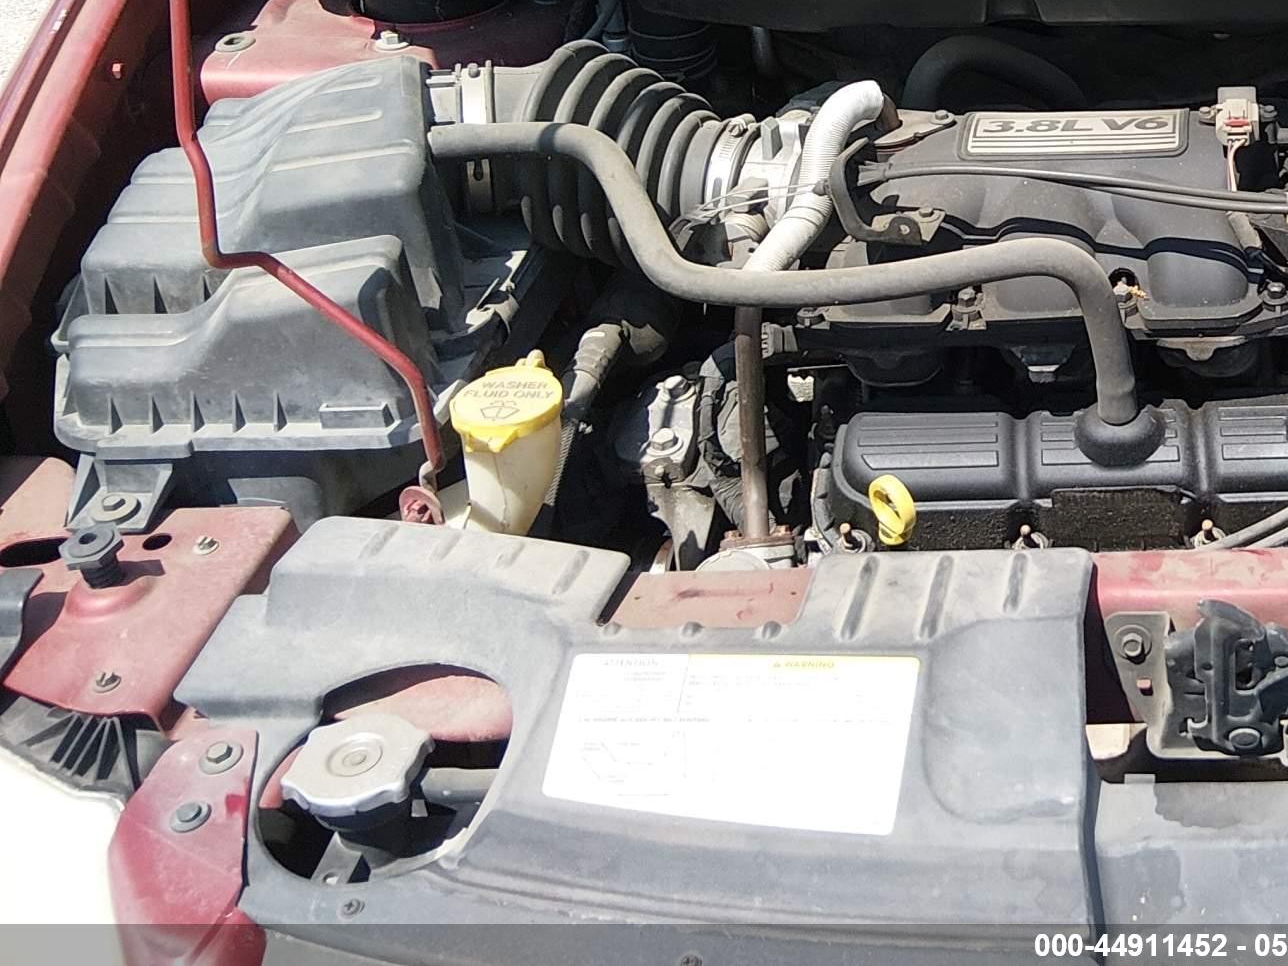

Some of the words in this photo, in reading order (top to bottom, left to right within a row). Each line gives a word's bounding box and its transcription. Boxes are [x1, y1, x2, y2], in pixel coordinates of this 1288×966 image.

[983, 118, 1092, 133] 3.8L
[1101, 116, 1169, 132] V6
[482, 381, 547, 390] WASHER
[464, 389, 510, 398] FLUID
[513, 389, 555, 400] ONLY
